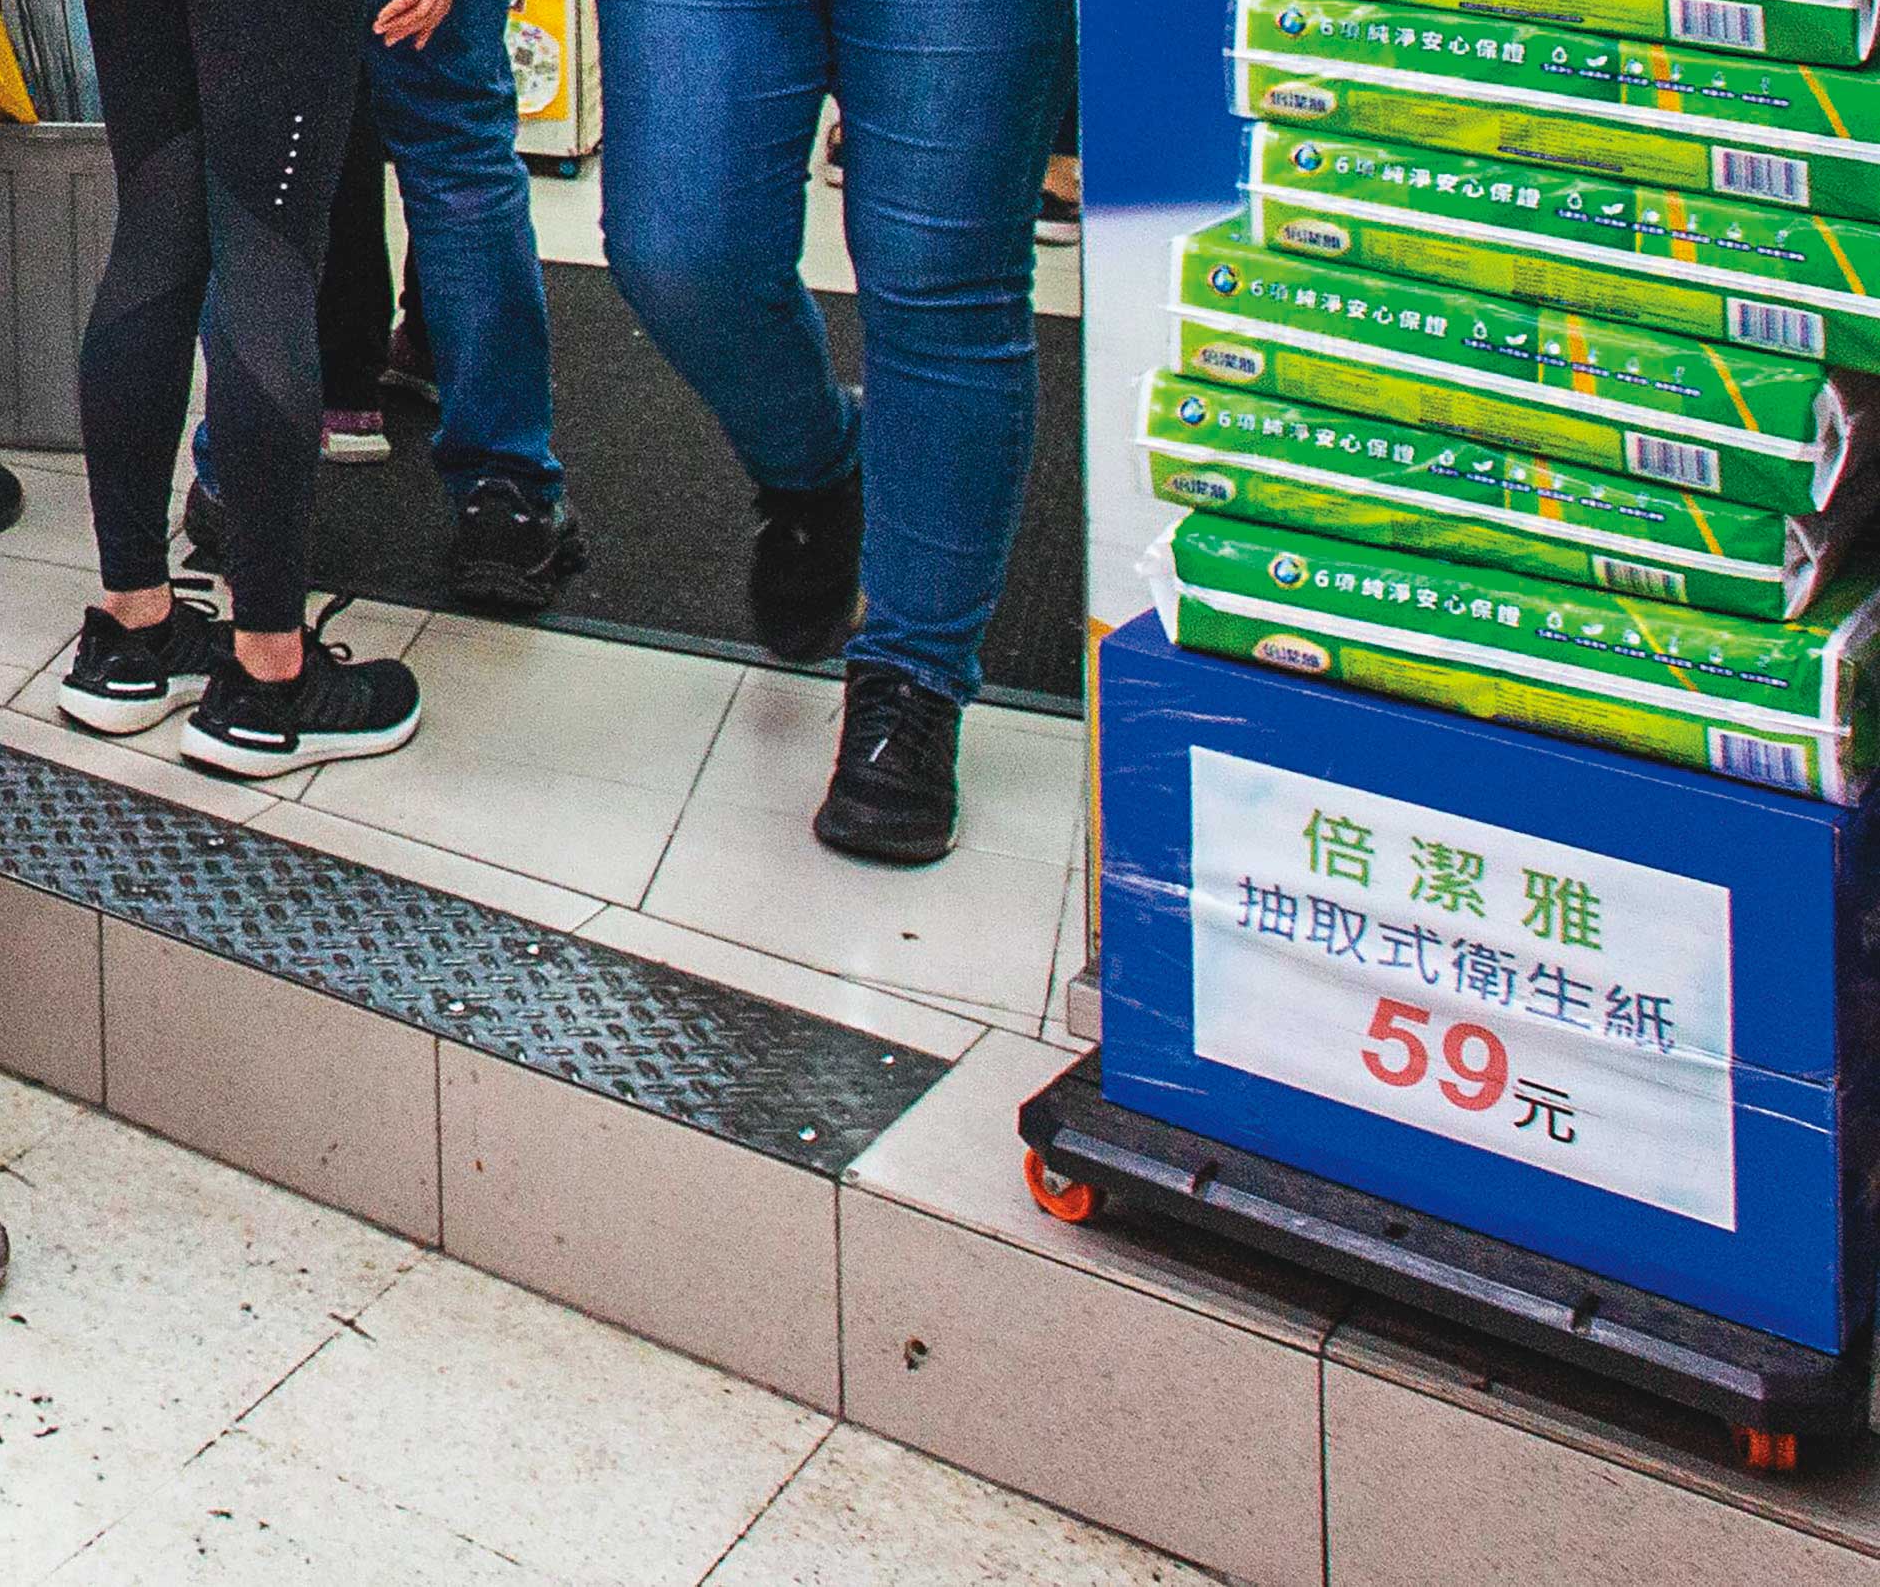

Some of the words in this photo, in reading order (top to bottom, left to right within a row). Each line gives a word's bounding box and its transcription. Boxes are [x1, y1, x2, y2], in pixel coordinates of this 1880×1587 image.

[1318, 17, 1527, 66] 6項純淨安心保證
[1334, 154, 1542, 210] 6項純淨安心保證
[1250, 278, 1449, 339] 6項純淨安心保證
[1218, 408, 1416, 466] 6項純淨安心保證
[1314, 567, 1523, 629] 6項純淨安心保證
[1301, 807, 1603, 953] 倍潔雅
[1237, 874, 1676, 1056] 抽取式衛生紙
